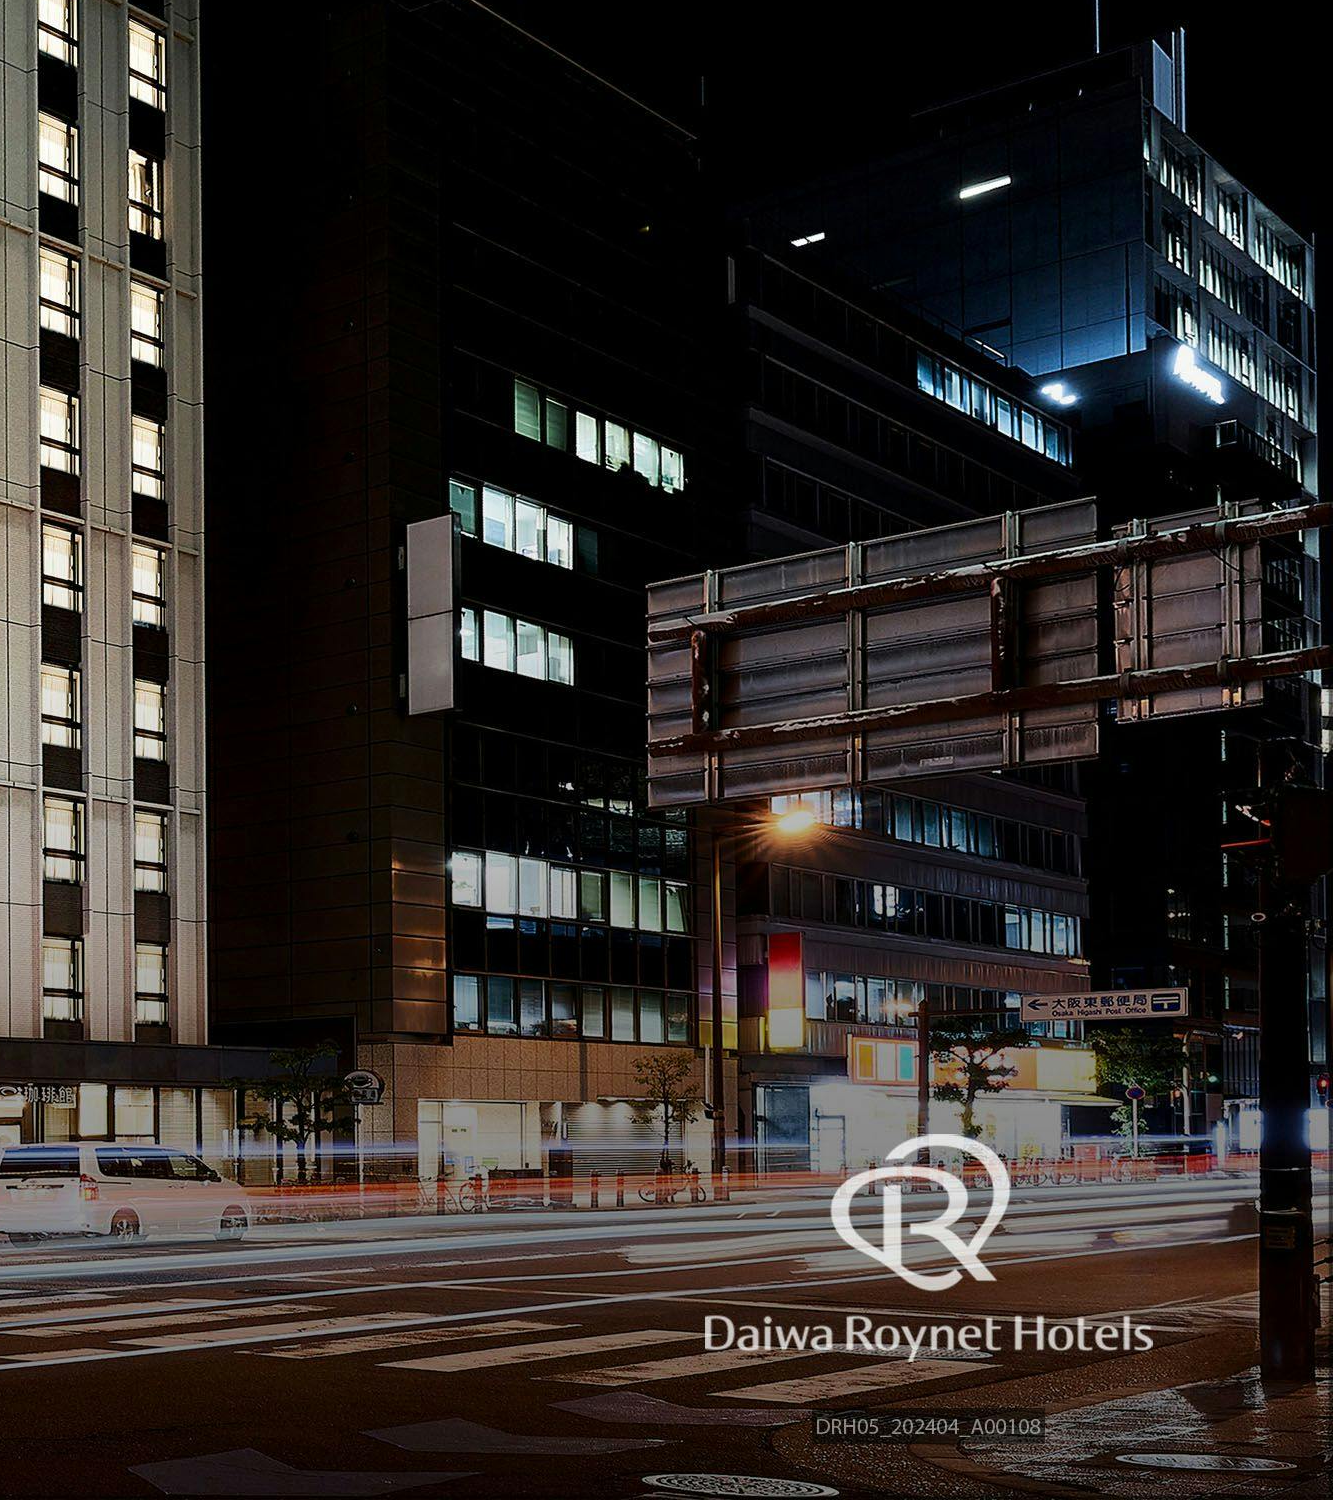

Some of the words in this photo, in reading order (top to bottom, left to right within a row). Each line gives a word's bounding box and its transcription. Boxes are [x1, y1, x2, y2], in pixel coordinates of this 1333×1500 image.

[1051, 994, 1148, 1010] 大阪東郵便局
[1051, 1009, 1074, 1017] Osaka
[1077, 1008, 1103, 1017] Higashi
[1106, 1007, 1122, 1015] Post
[1125, 1006, 1147, 1014] Office
